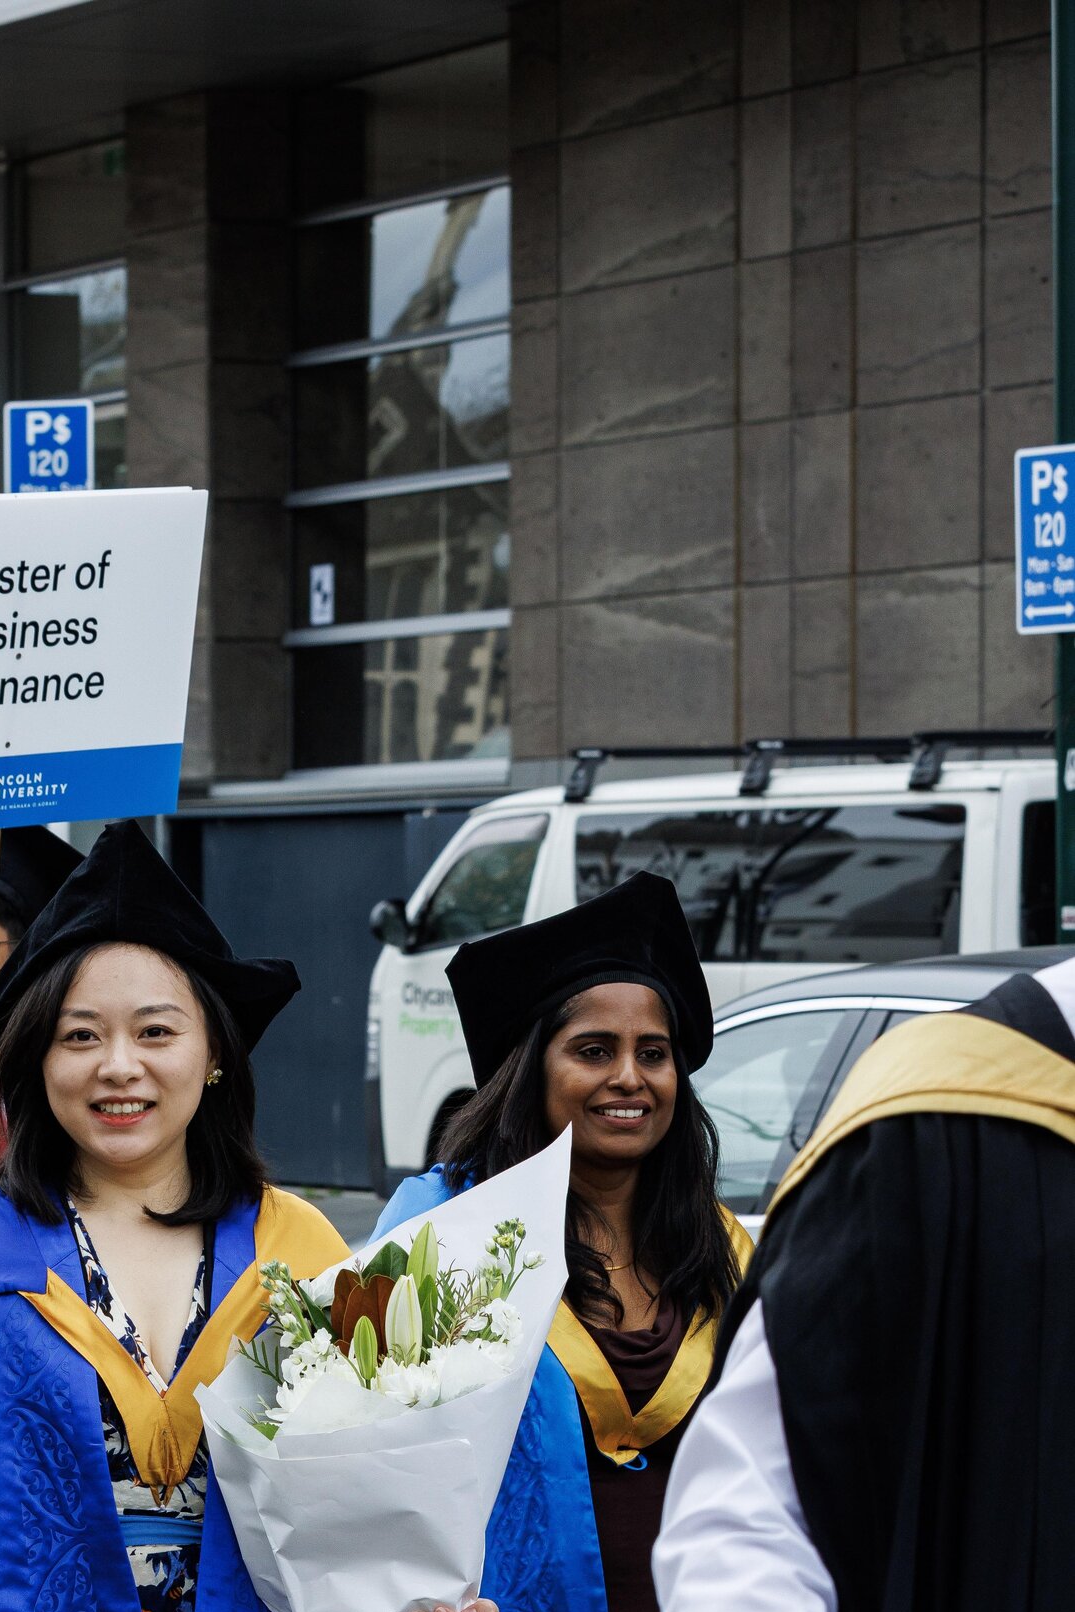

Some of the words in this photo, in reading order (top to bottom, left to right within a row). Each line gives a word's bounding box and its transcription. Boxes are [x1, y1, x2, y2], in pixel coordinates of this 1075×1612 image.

[28, 448, 69, 477] 120
[1034, 511, 1066, 548] 120
[75, 549, 112, 590] of
